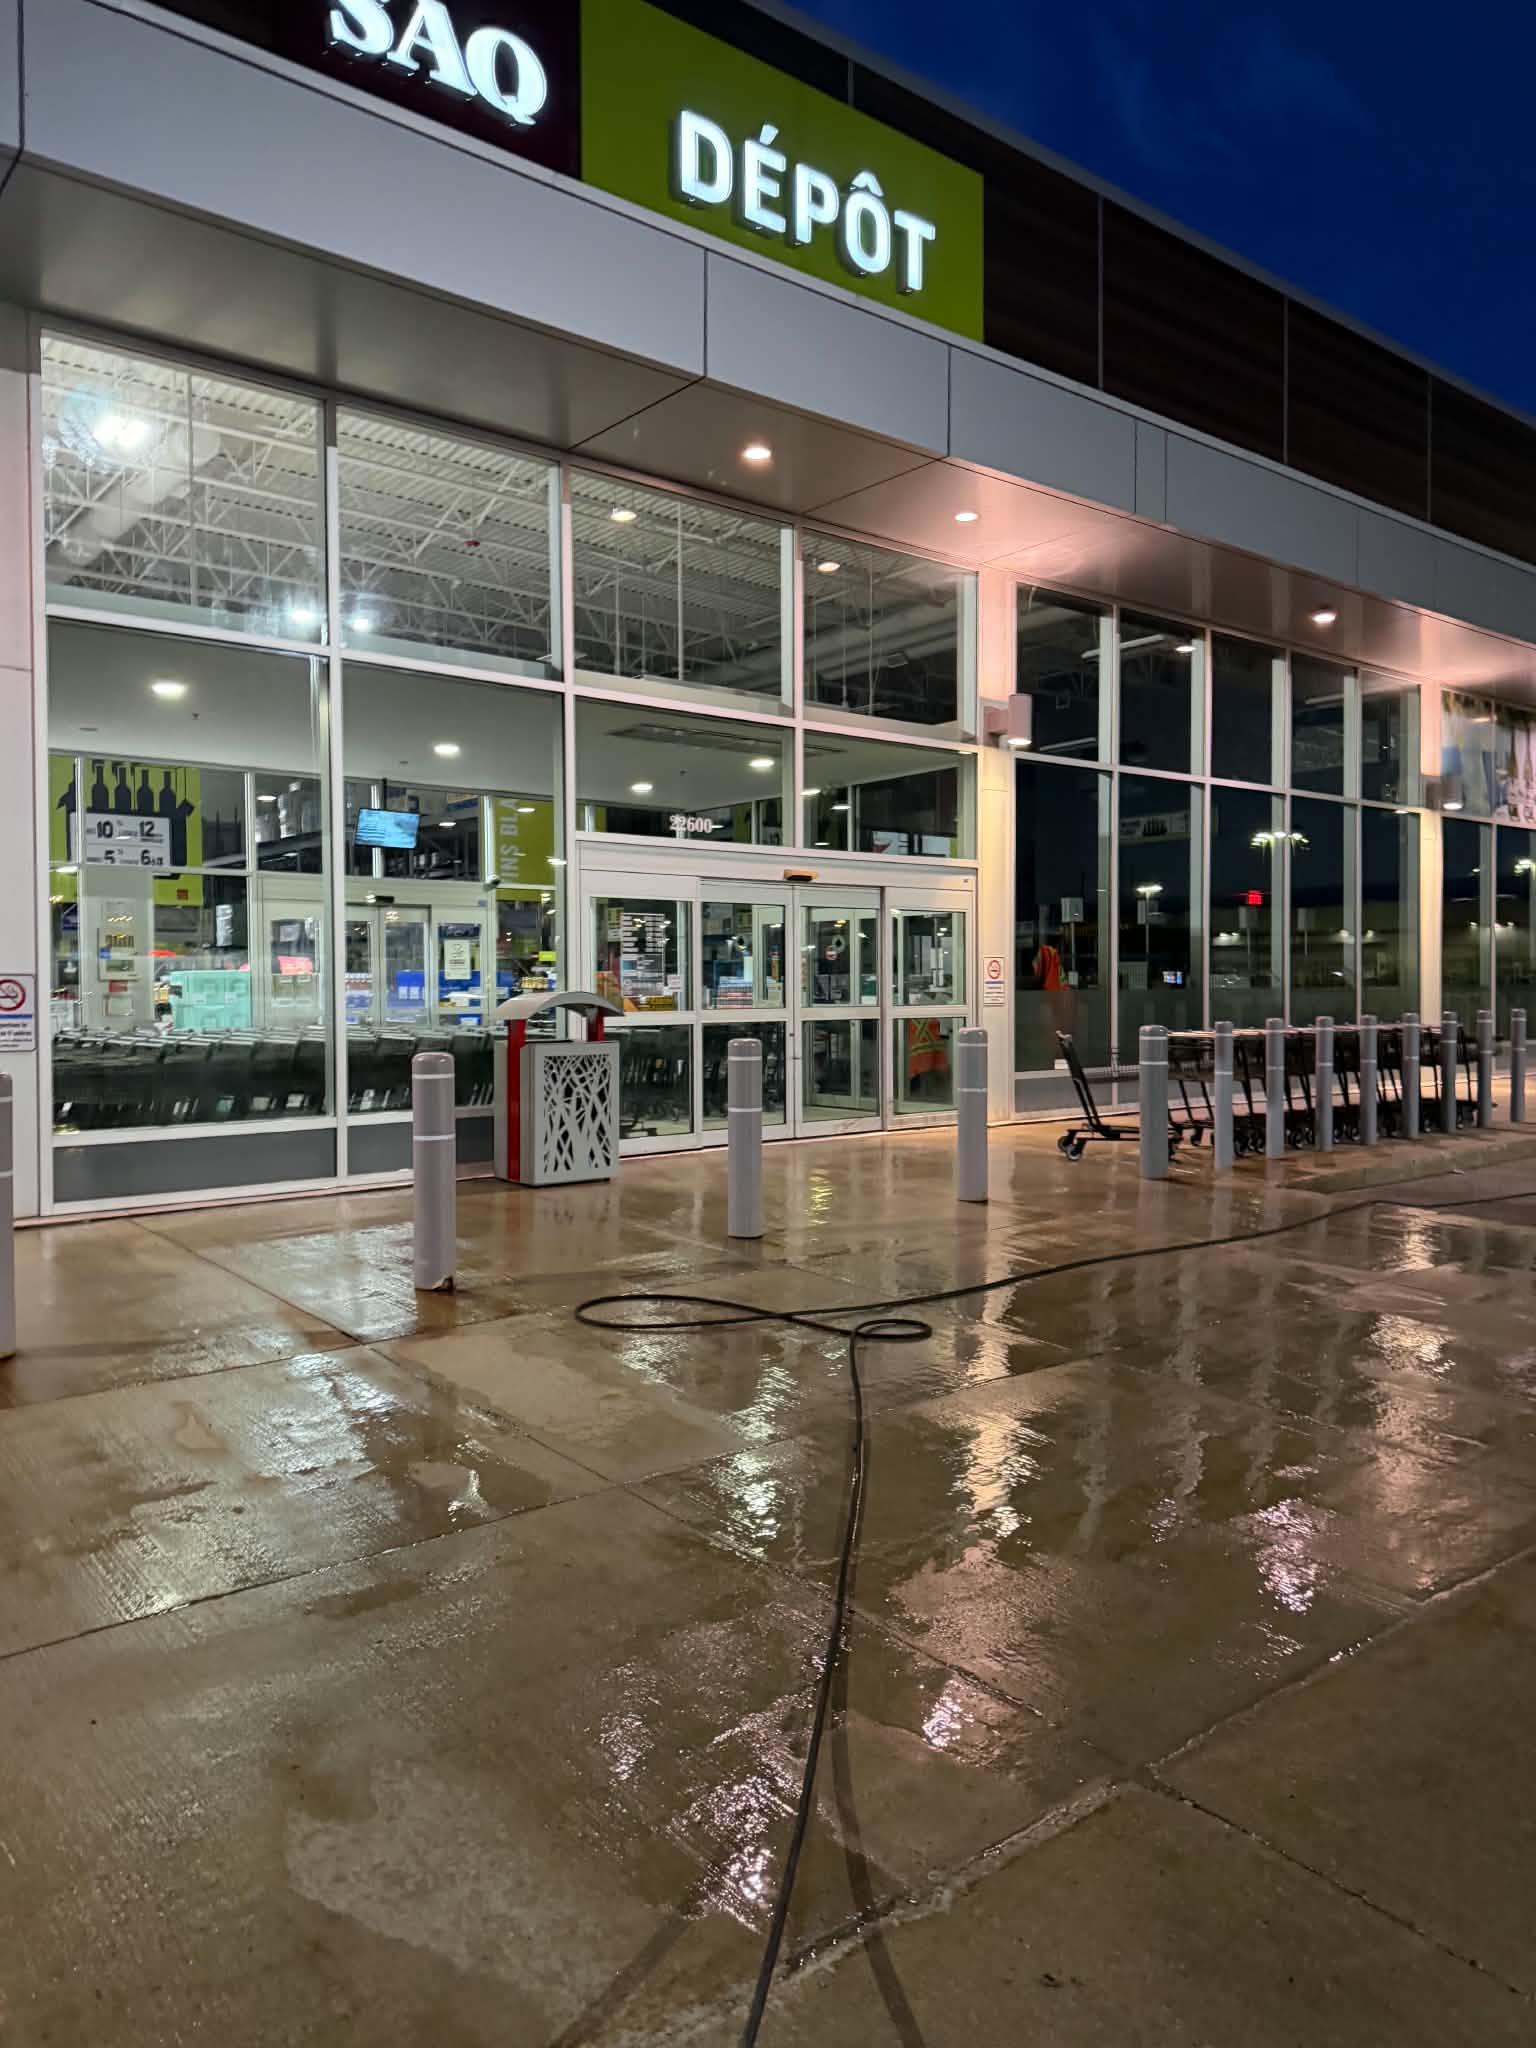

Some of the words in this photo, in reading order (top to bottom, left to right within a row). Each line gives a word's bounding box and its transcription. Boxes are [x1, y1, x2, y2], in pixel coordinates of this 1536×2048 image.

[330, 0, 548, 126] SAQ
[679, 109, 936, 291] DÉPÔT
[96, 820, 114, 839] 10
[139, 820, 155, 837] 12
[670, 815, 713, 834] 22600
